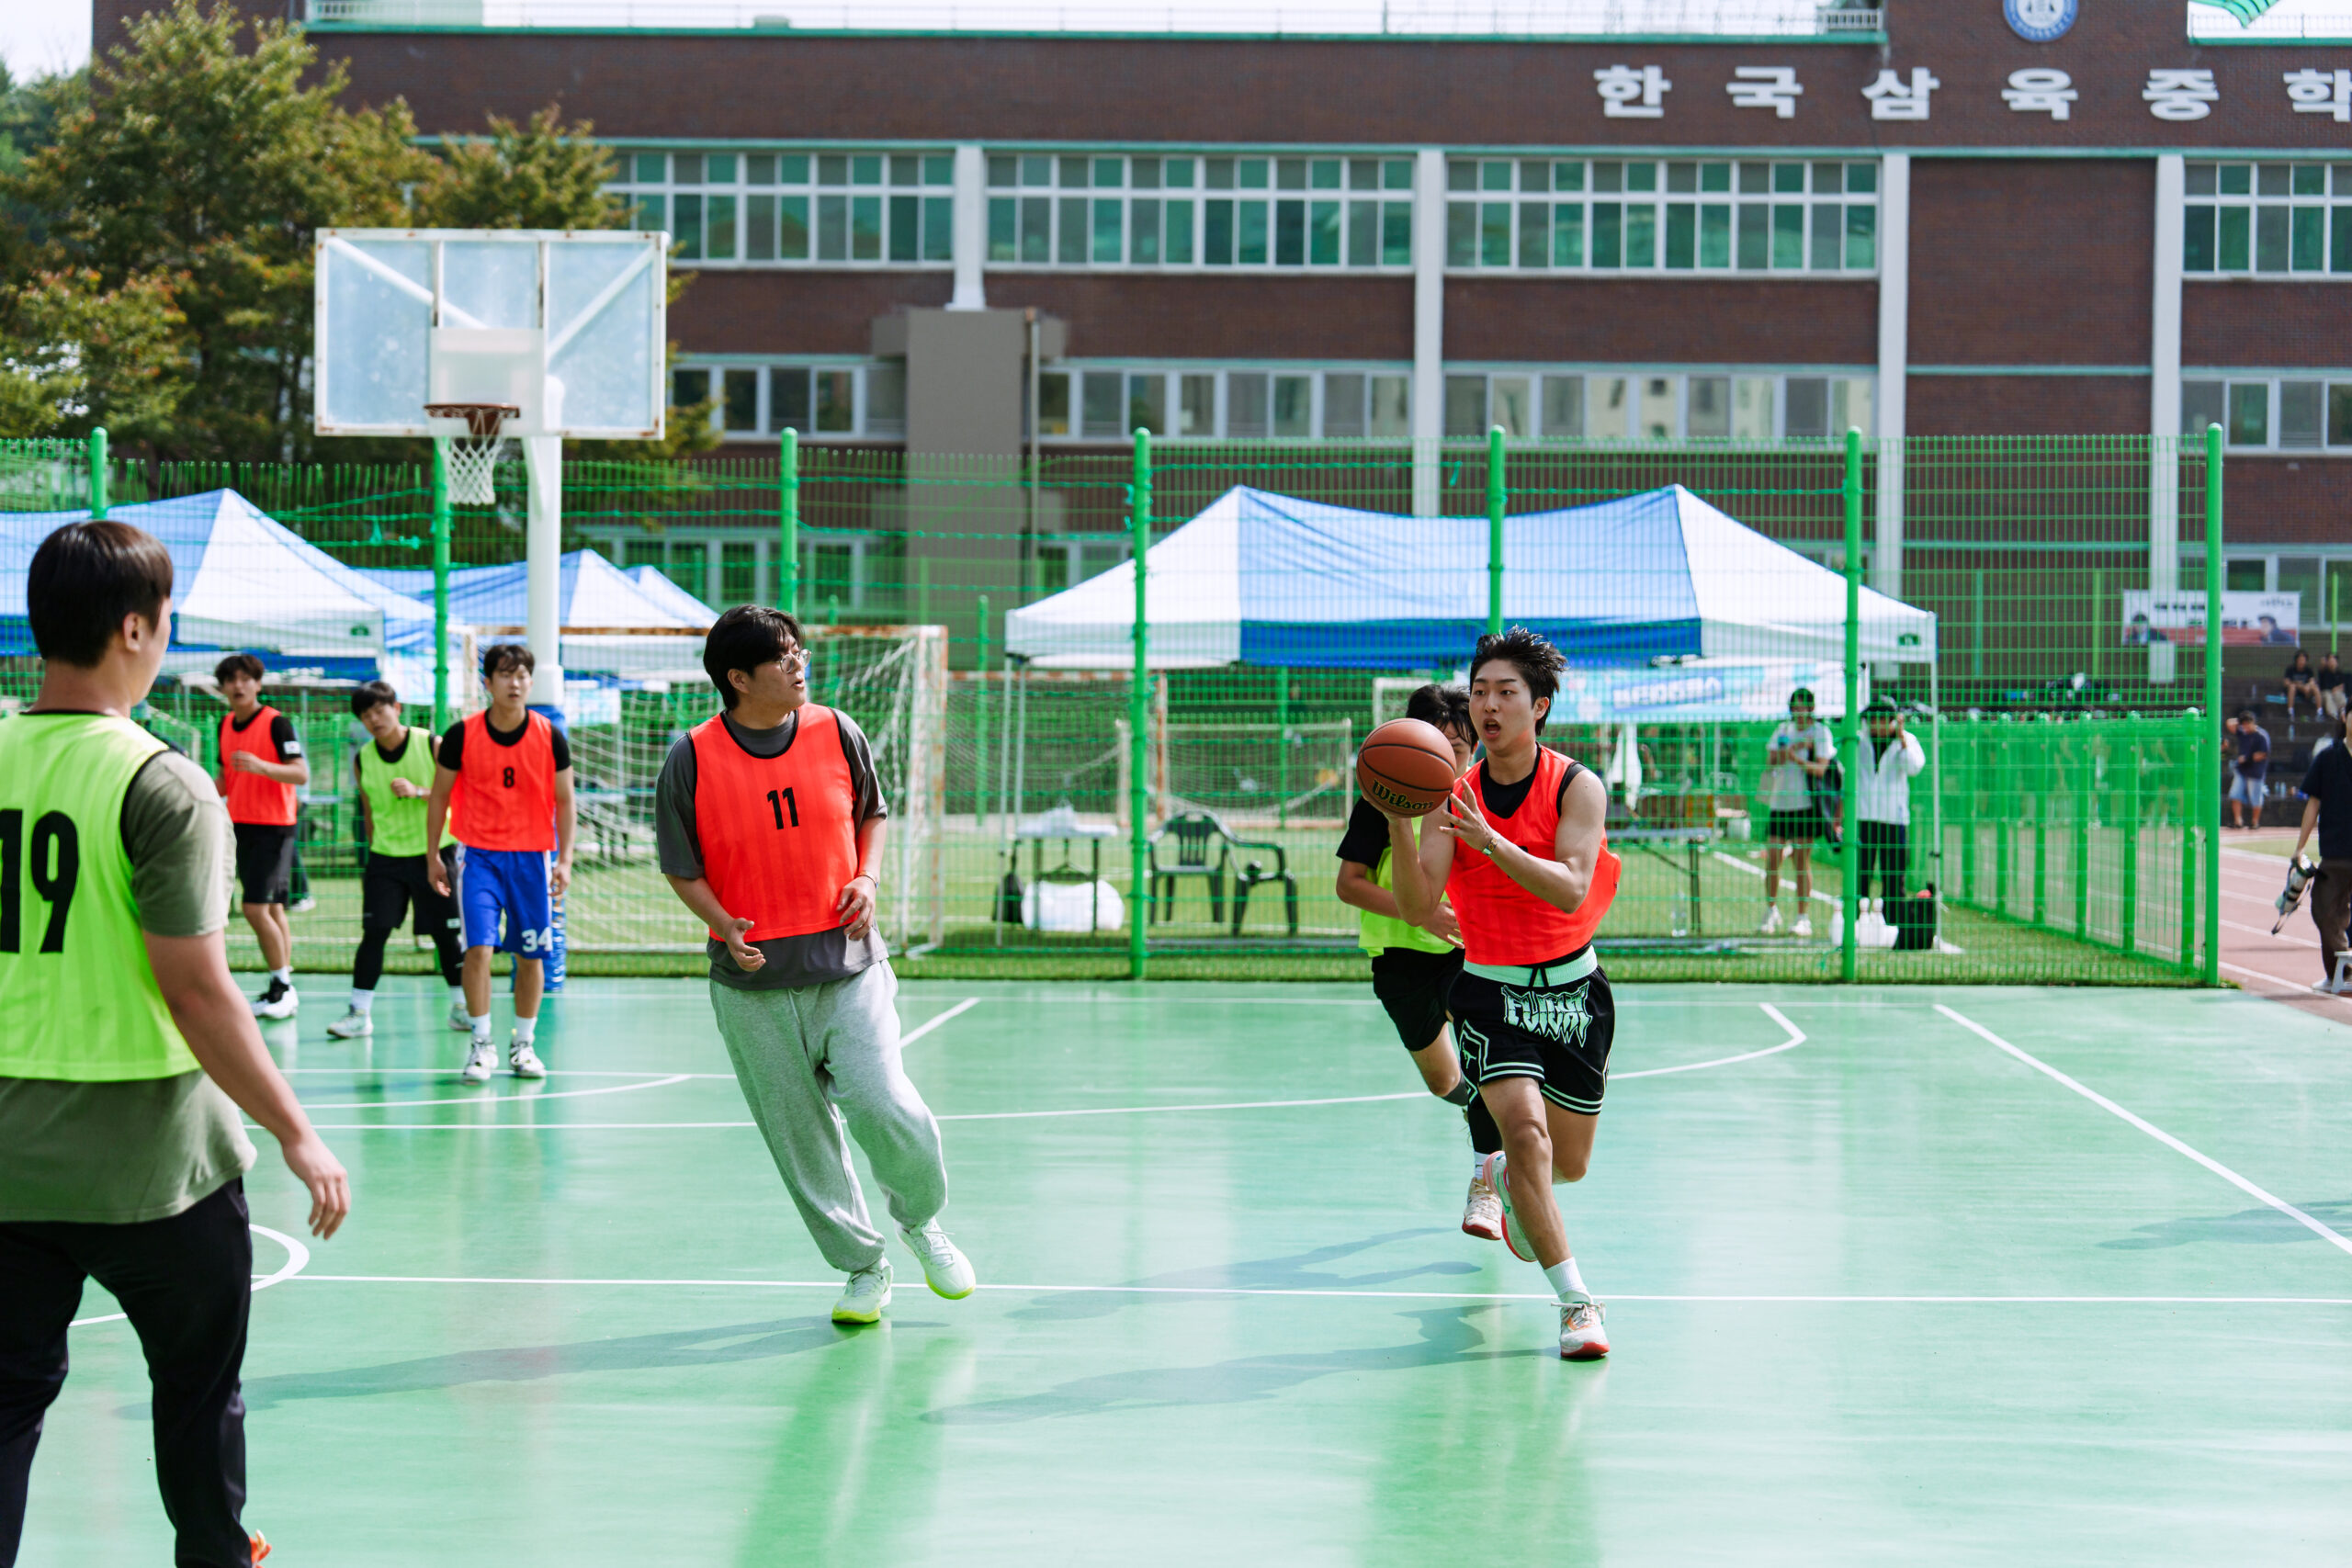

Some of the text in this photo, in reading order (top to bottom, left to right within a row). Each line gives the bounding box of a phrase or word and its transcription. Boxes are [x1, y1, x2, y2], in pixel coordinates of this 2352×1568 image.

[503, 766, 514, 788] 8
[766, 786, 799, 830] 11
[1372, 778, 1434, 810] Wilson
[0, 808, 80, 954] 19
[521, 926, 553, 953] 34
